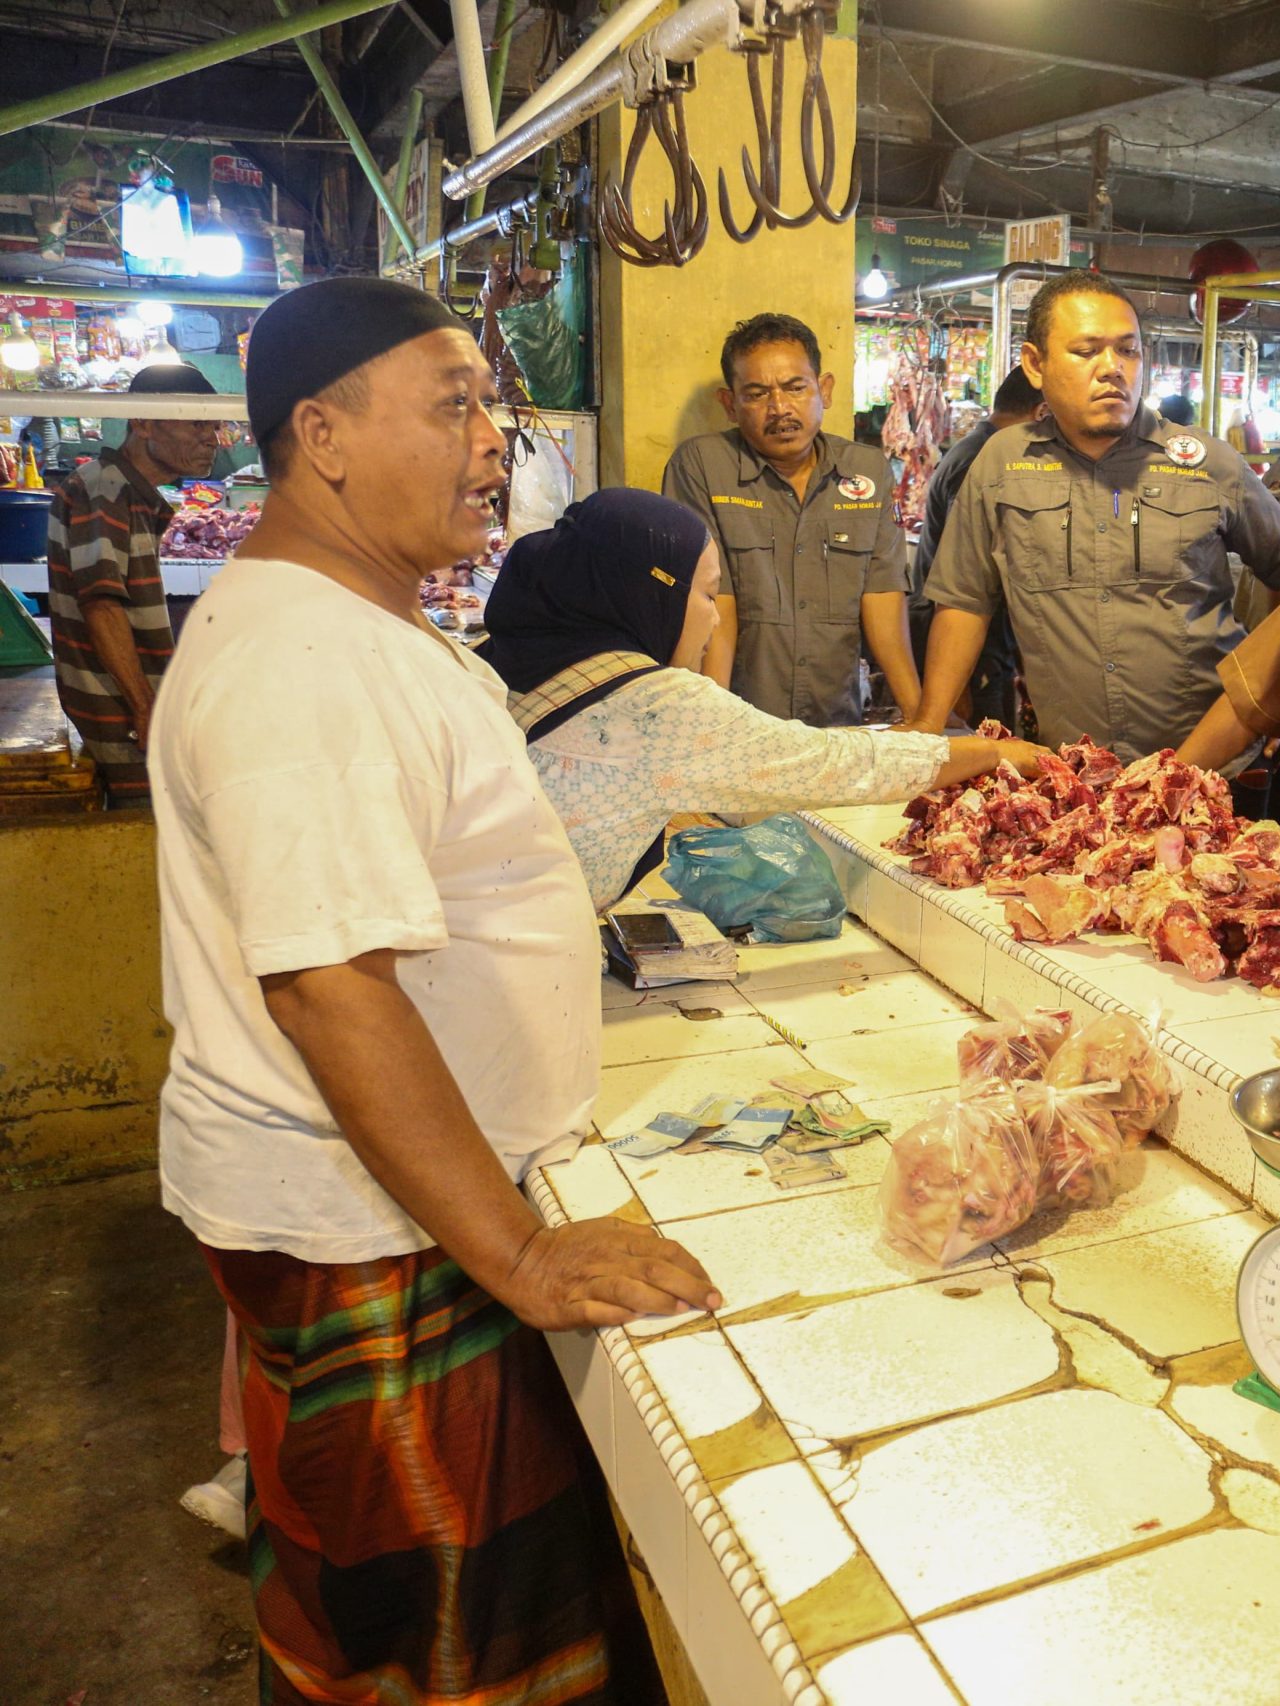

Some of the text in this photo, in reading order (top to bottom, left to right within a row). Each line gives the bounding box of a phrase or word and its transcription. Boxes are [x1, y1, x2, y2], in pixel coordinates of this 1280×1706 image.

[904, 235, 932, 247] TOKO
[933, 239, 970, 250] SINAGA
[911, 256, 963, 268] PASAR HORAS
